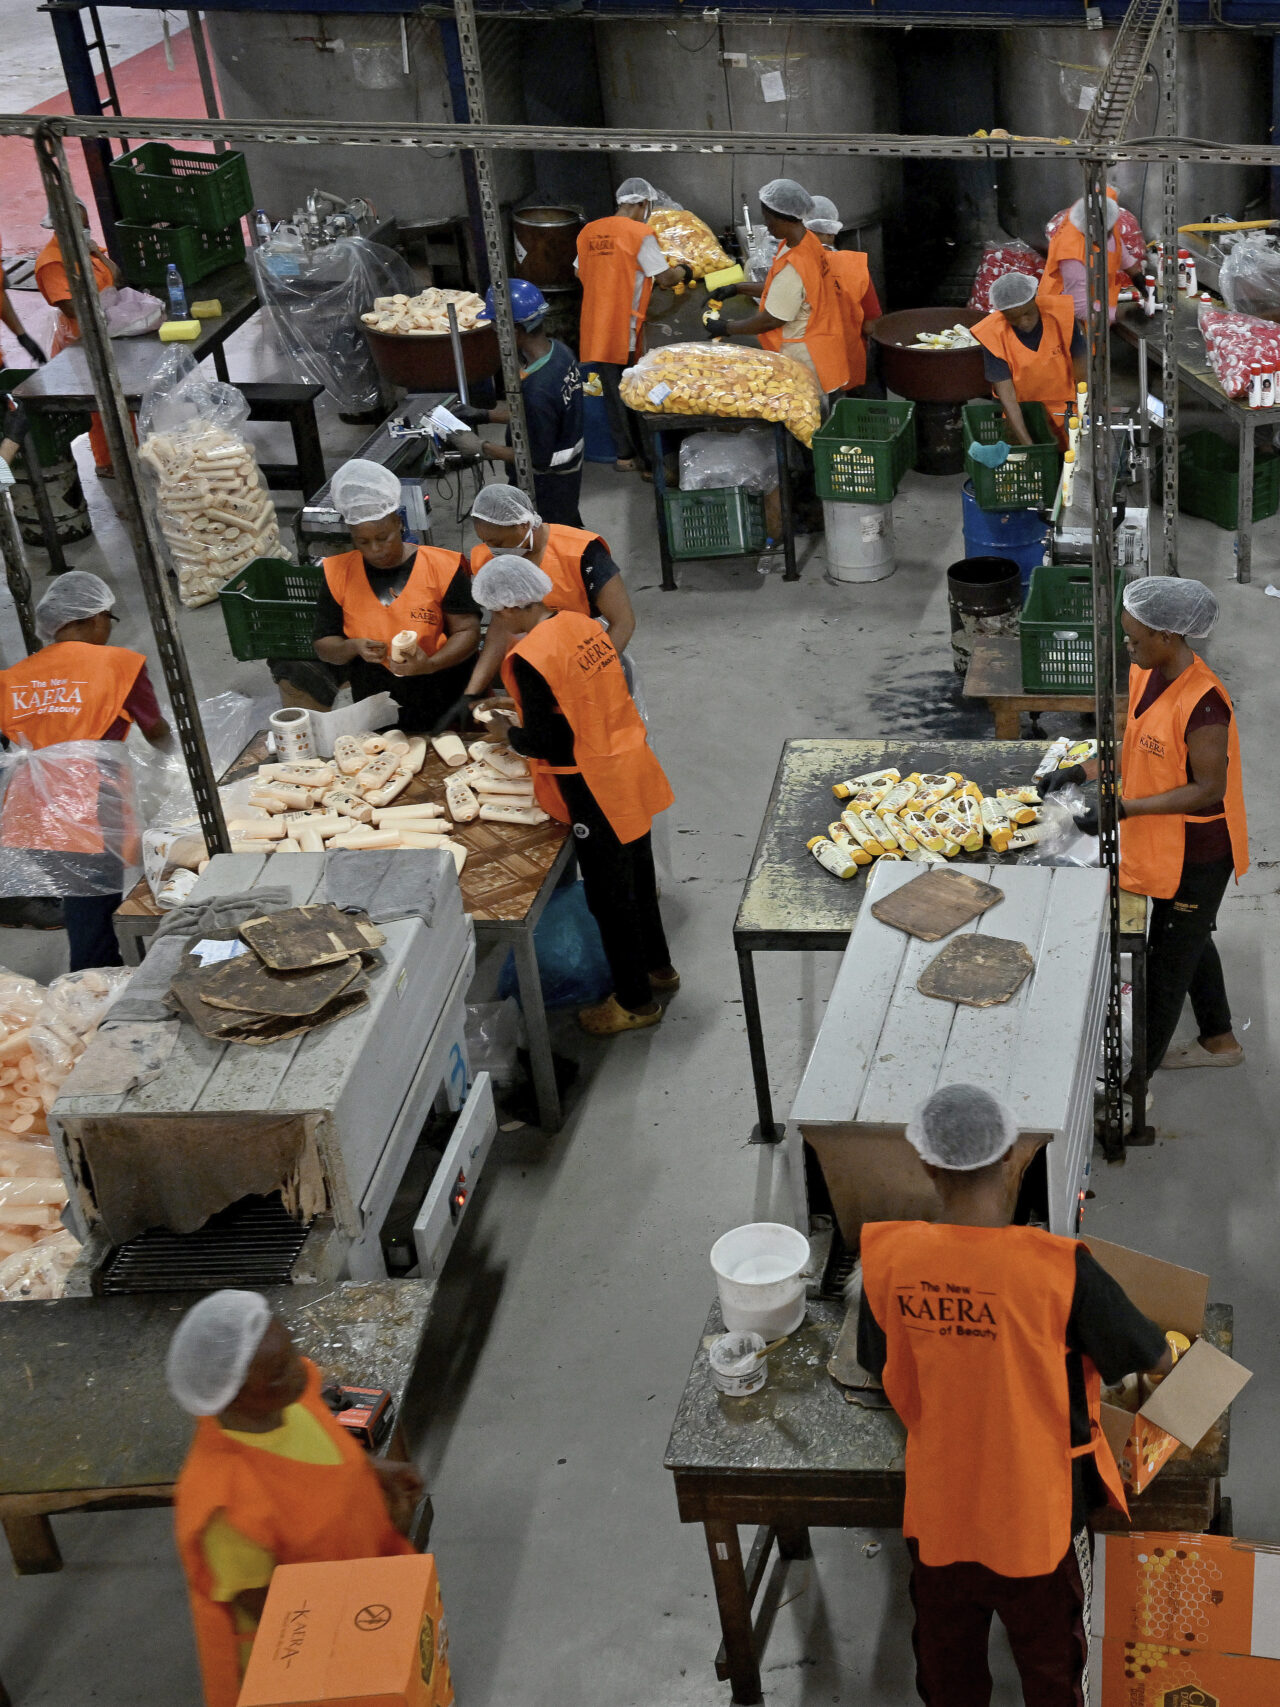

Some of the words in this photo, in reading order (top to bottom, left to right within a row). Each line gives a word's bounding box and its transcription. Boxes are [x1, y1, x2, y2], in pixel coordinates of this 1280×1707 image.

[576, 640, 613, 673] KAERA
[30, 680, 47, 688] The
[50, 678, 68, 686] New
[12, 687, 82, 710] KAERA
[48, 706, 82, 716] Beauty
[920, 1281, 940, 1293] The
[946, 1284, 971, 1294] New
[896, 1295, 996, 1325] KAERA
[940, 1326, 952, 1336] of
[956, 1326, 997, 1342] Beauty
